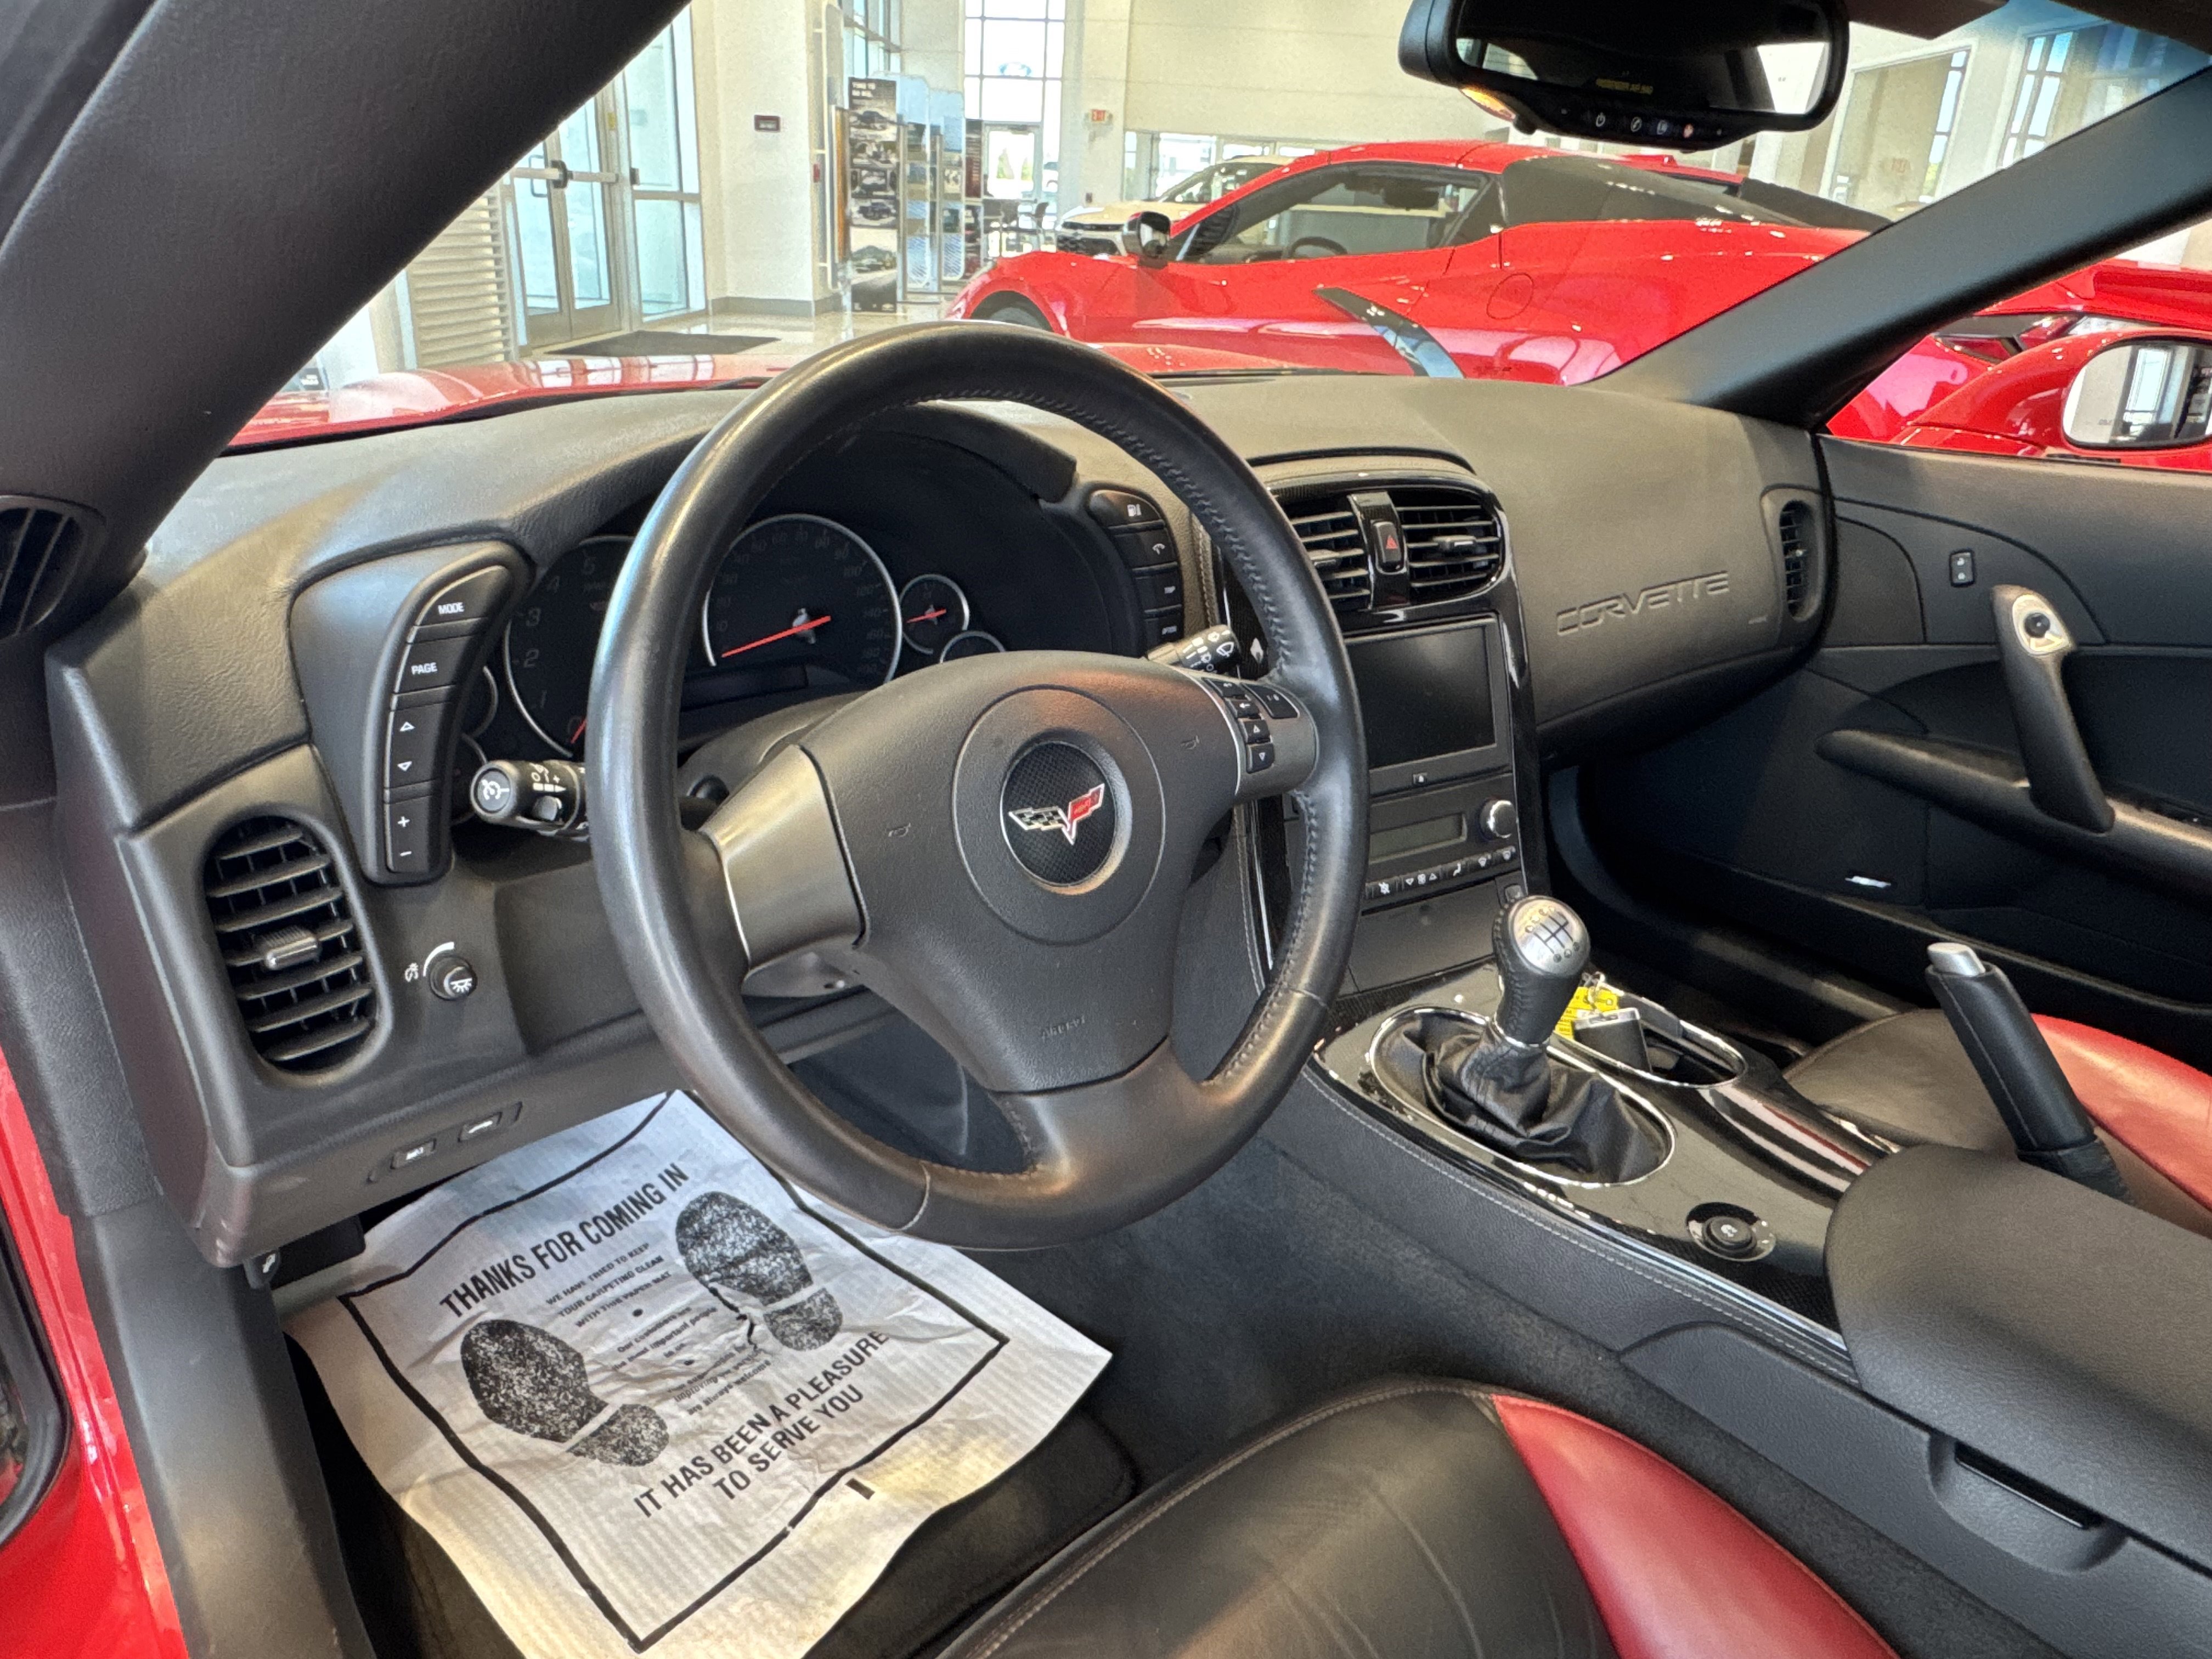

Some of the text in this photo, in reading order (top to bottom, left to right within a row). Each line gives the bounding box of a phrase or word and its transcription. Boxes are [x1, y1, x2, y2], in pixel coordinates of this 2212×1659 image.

[438, 602, 465, 614] MODE
[526, 607, 541, 627] 3
[1556, 569, 1729, 636] CORVETTE
[411, 662, 438, 675] PAGE
[523, 648, 540, 668] 2
[440, 1163, 690, 1318] THANKS FOR COMING IN
[546, 1293, 563, 1305] WE
[614, 1255, 629, 1265] TO
[558, 1299, 586, 1317] YOUR
[635, 1255, 665, 1274] CLEAN
[634, 1331, 890, 1517] IT HAS BEEN A PLEASURE
[713, 1384, 864, 1500] TO SERVE YOU
